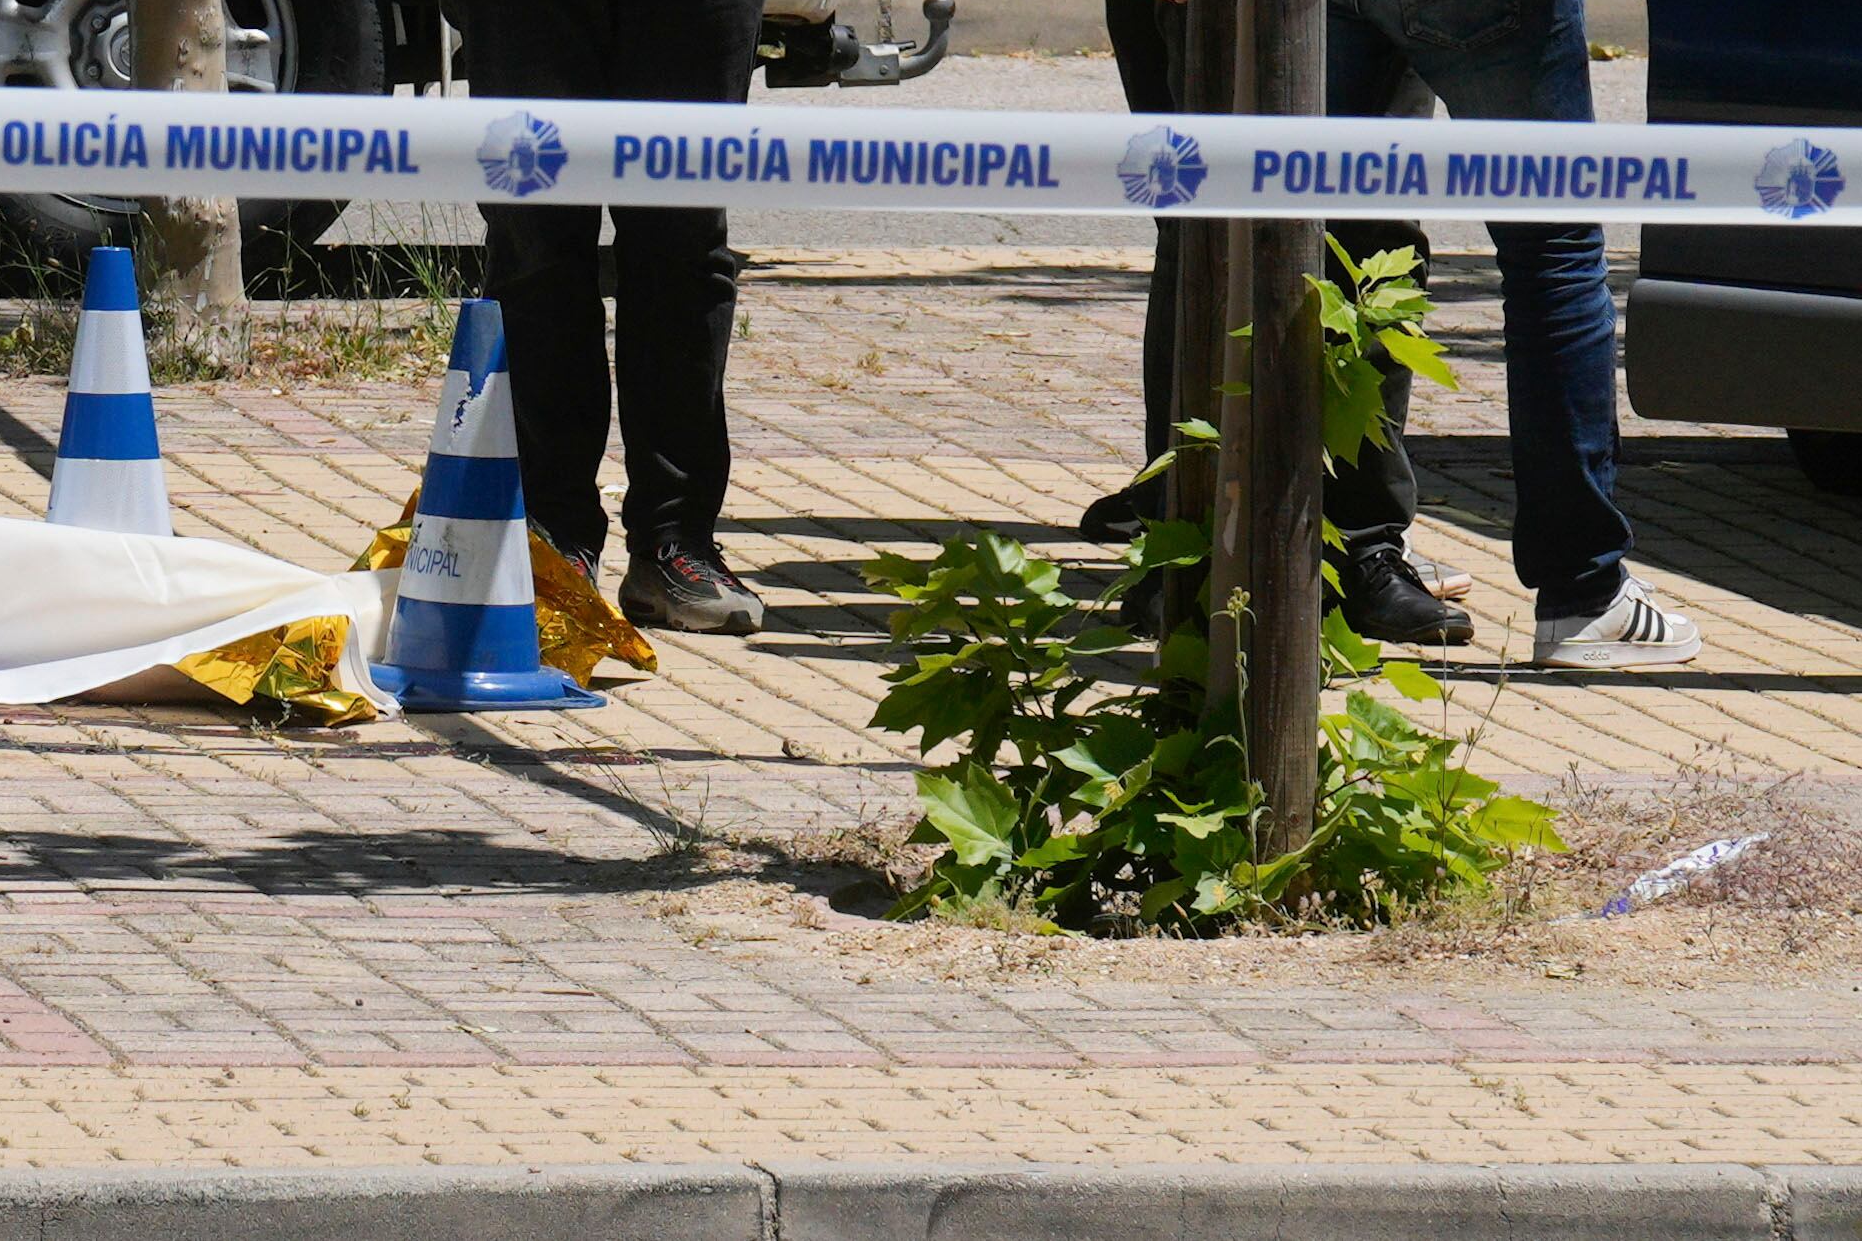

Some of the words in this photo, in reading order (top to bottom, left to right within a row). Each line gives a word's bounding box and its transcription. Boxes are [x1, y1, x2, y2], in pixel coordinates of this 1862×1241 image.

[165, 125, 419, 175] MUNICIPAL
[613, 127, 790, 183] POLICÍA
[809, 139, 1058, 188] MUNICIPAL
[1252, 140, 1428, 196] POLICÍA
[1445, 153, 1696, 202] MUNICIPAL
